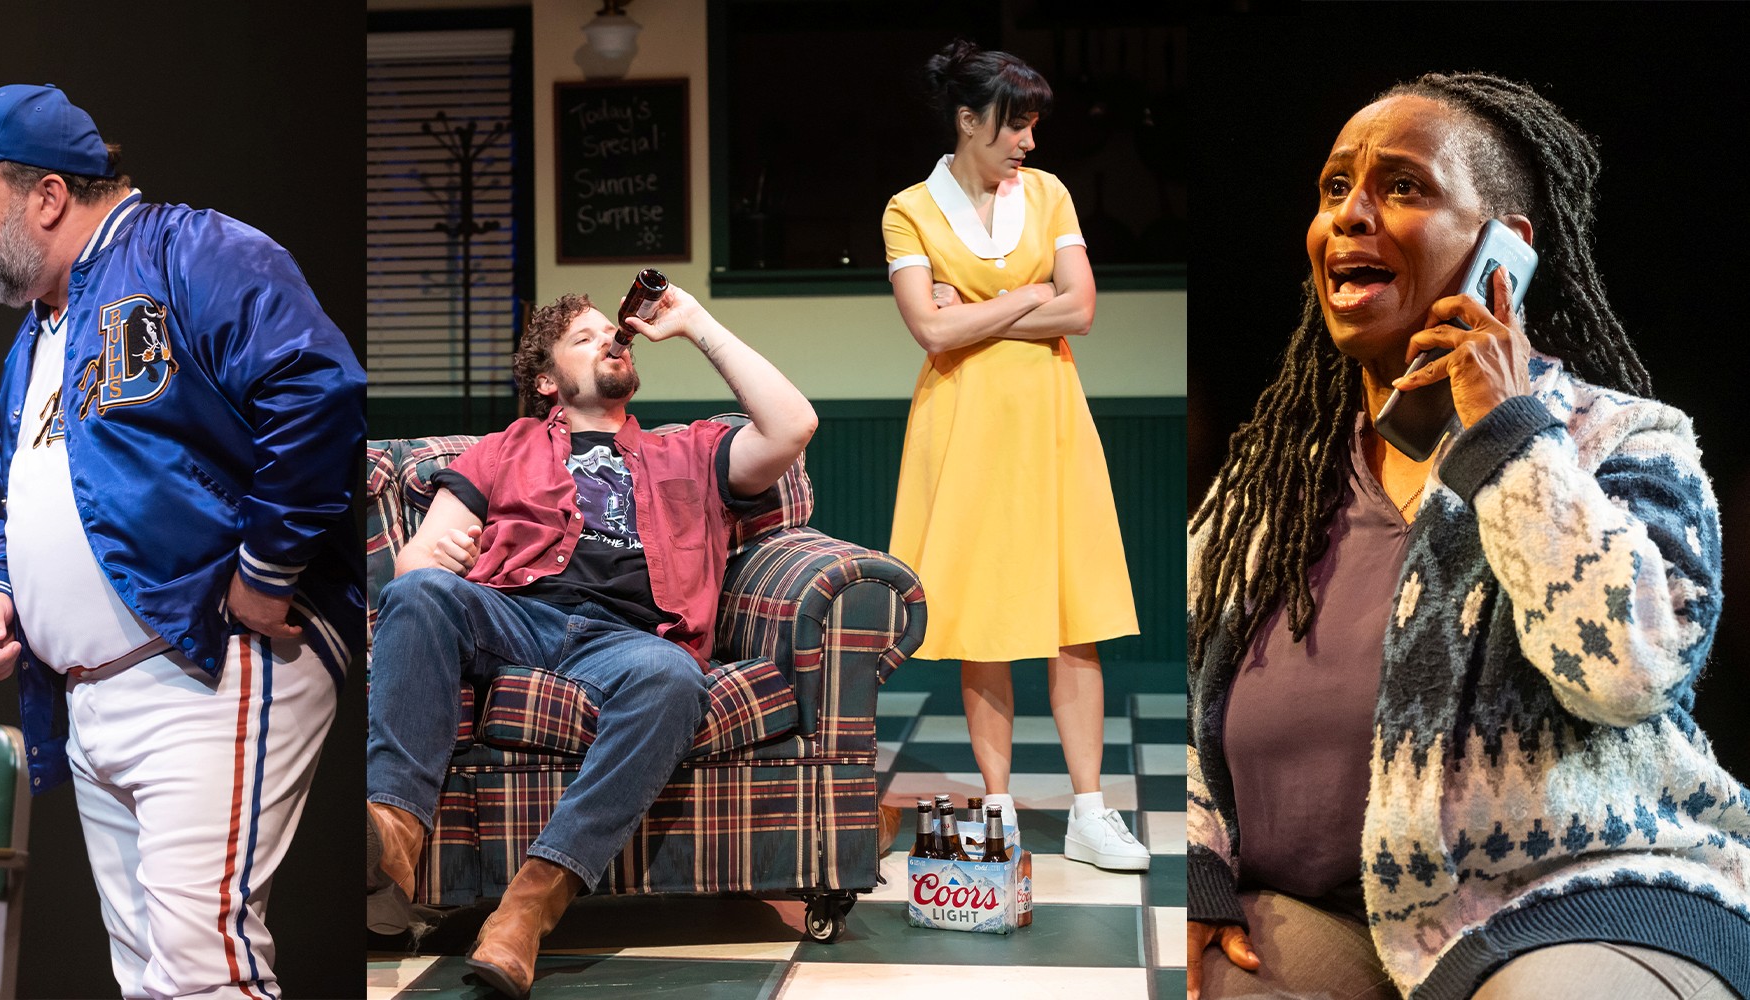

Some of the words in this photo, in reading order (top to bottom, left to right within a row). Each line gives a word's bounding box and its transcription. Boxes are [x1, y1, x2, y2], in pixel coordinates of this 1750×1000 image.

[569, 96, 651, 133] Today's
[575, 168, 658, 199] Sunrise
[577, 204, 664, 234] Surprise
[109, 310, 122, 399] BULLS
[912, 873, 999, 910] Coors
[932, 908, 979, 923] LIGHT
